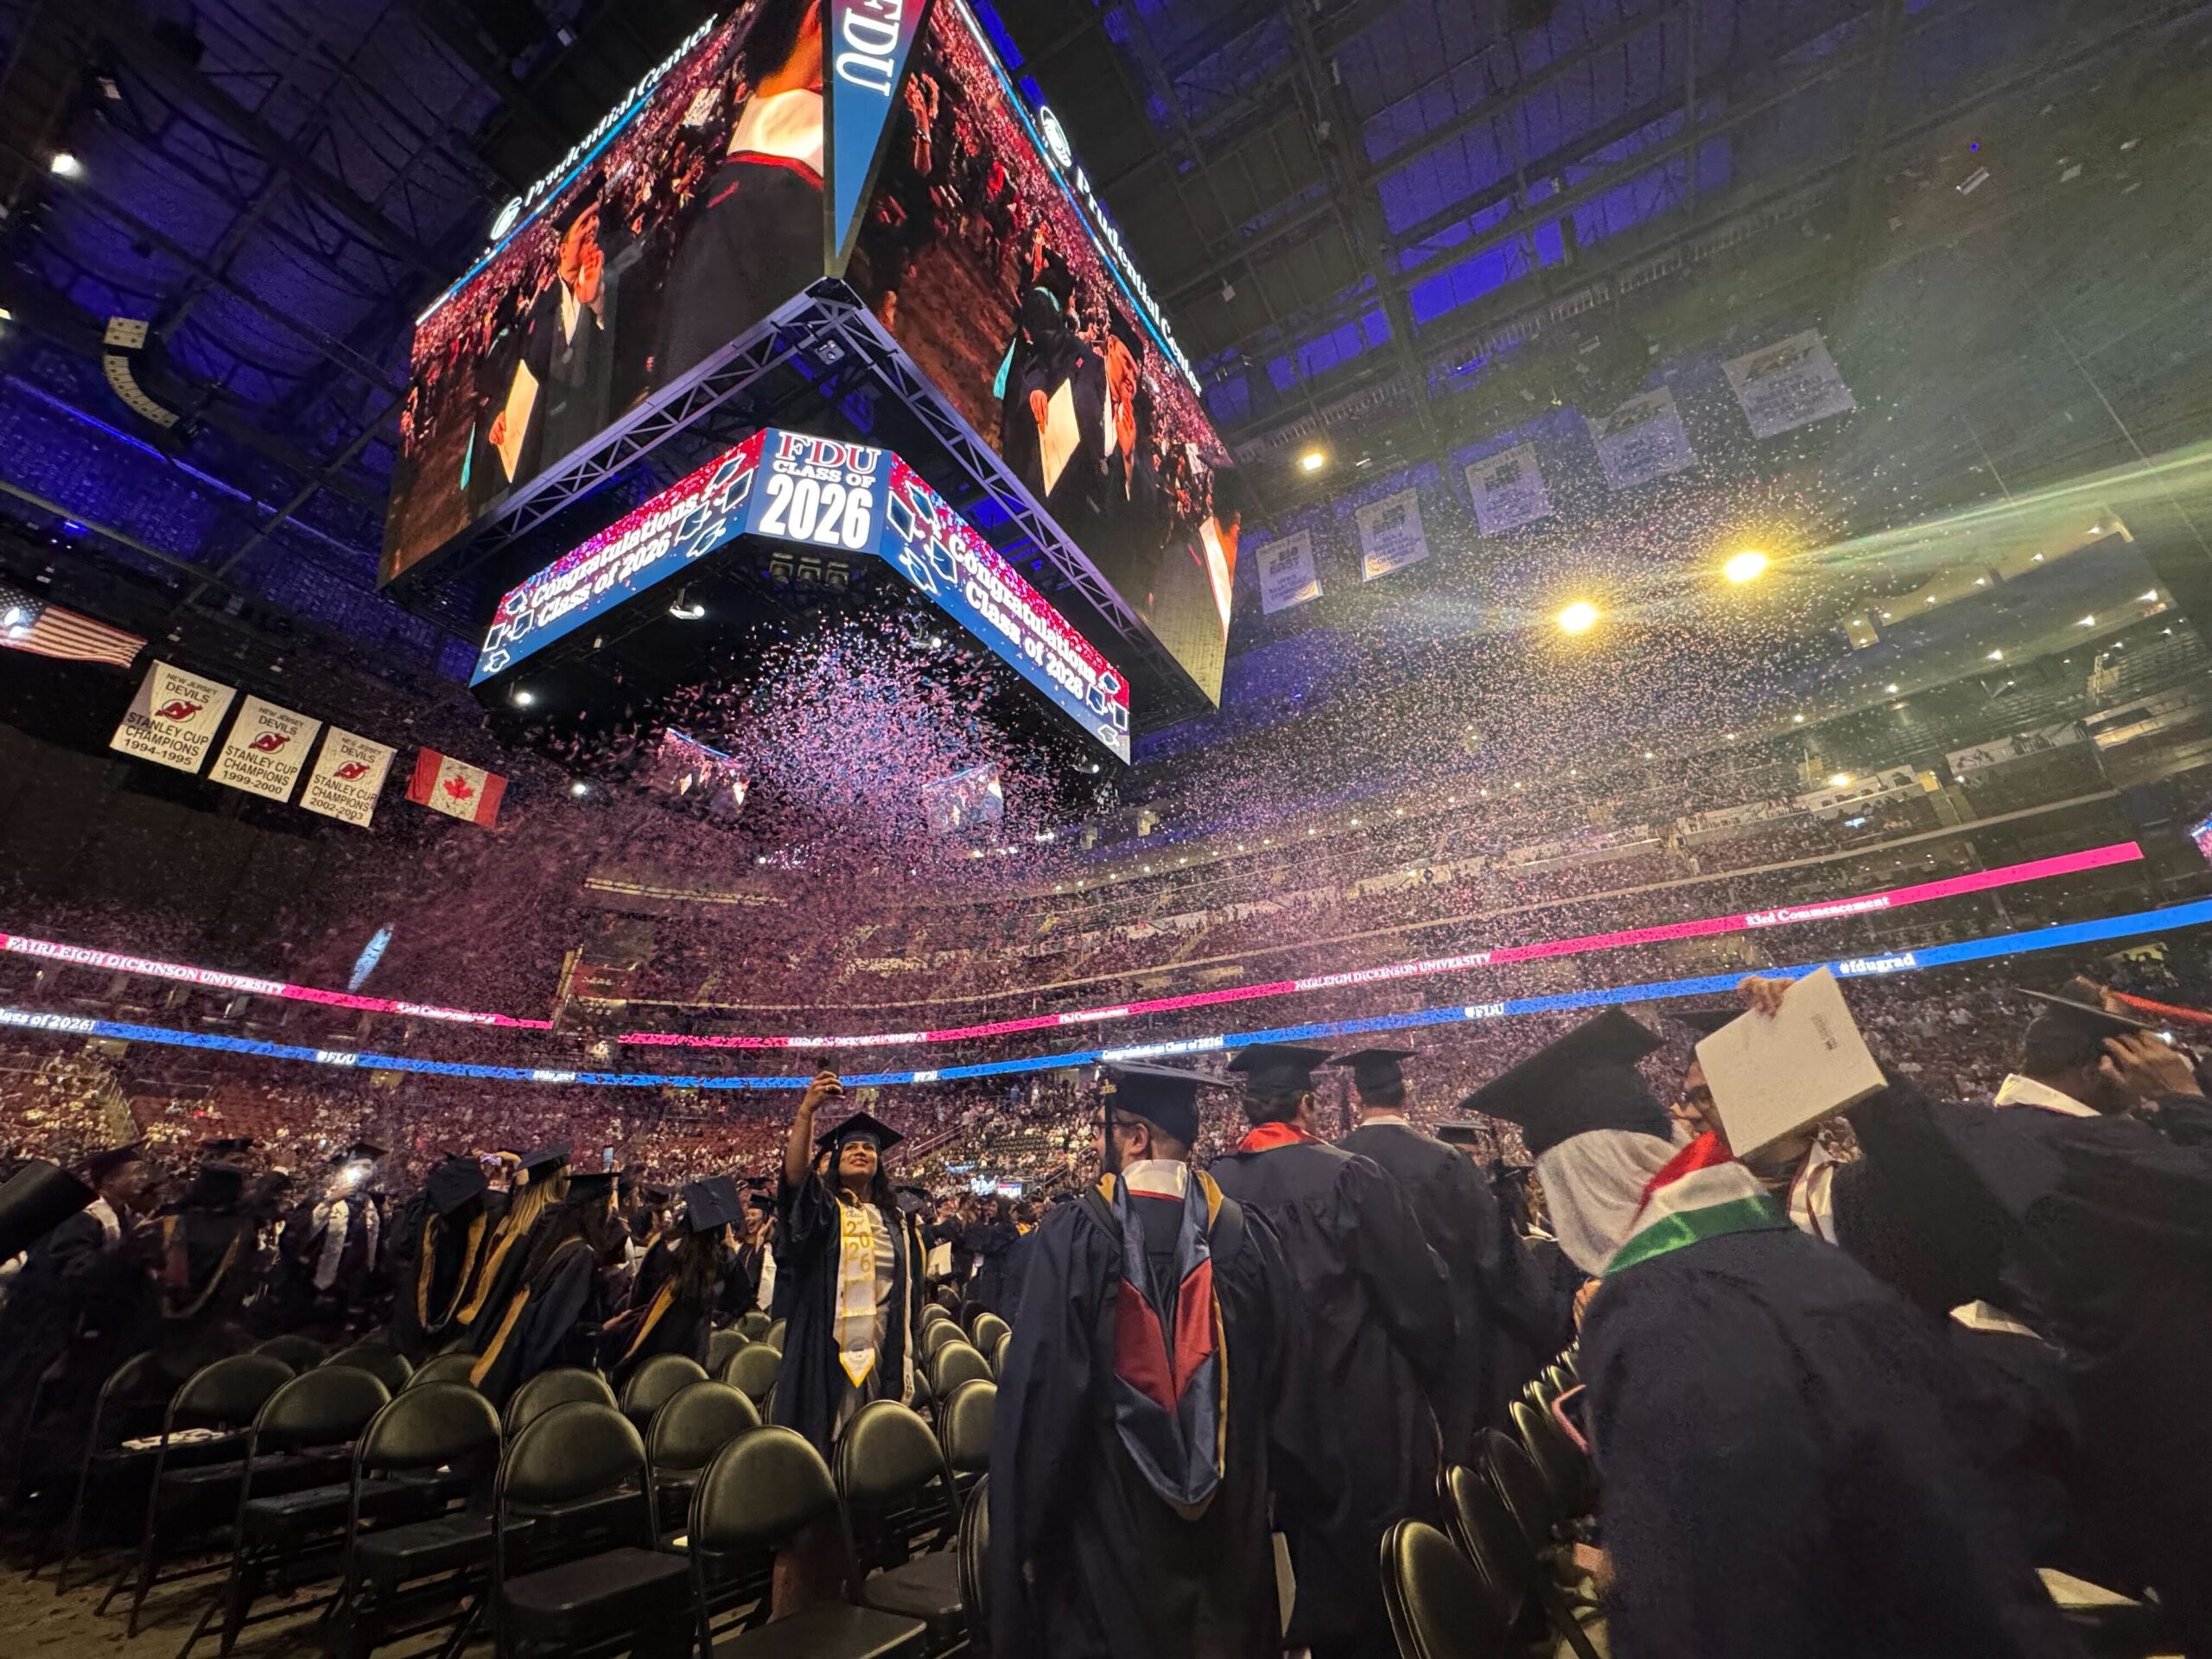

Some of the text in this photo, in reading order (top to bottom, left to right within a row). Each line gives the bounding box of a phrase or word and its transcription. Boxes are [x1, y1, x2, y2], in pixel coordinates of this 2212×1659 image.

[524, 13, 719, 207] Prudential Center
[1077, 165, 1202, 397] Prudential Center
[775, 431, 881, 474] FDU
[772, 460, 876, 488] CLASS OF
[759, 474, 874, 550] 2026
[532, 493, 699, 606] Congratulations
[537, 531, 671, 627] Class of 2026
[949, 534, 1096, 685] Congratulations
[966, 581, 1083, 700] Class of 2026
[165, 682, 210, 703] DEVILS
[166, 673, 218, 696] NEW JERSEY
[127, 712, 208, 745] STANLEY CUP
[258, 707, 304, 727] NEW JERSEY
[258, 715, 297, 735] DEVILS
[124, 739, 192, 766] 1994-1995
[125, 725, 200, 757] CHAMPIONS
[340, 745, 376, 764] DEVILS
[224, 758, 289, 786] CHAMPIONS
[226, 745, 298, 776] STANLEY CUP
[223, 771, 283, 794] 1999-2000
[314, 774, 378, 801] STANLEY CUP
[310, 798, 364, 820] 2002-2003
[312, 786, 370, 812] CHAMPIONS
[1745, 896, 1891, 925] 83rd Commencement
[7, 937, 286, 994] FAIRLEIGH DICKINSON UNIVERSITY
[1354, 964, 1417, 982] DICKINSON
[1419, 953, 1491, 972] UNIVERSITY
[1839, 952, 1916, 974] #fdugrad
[30, 1014, 52, 1027] of
[1476, 1002, 1503, 1017] FDU
